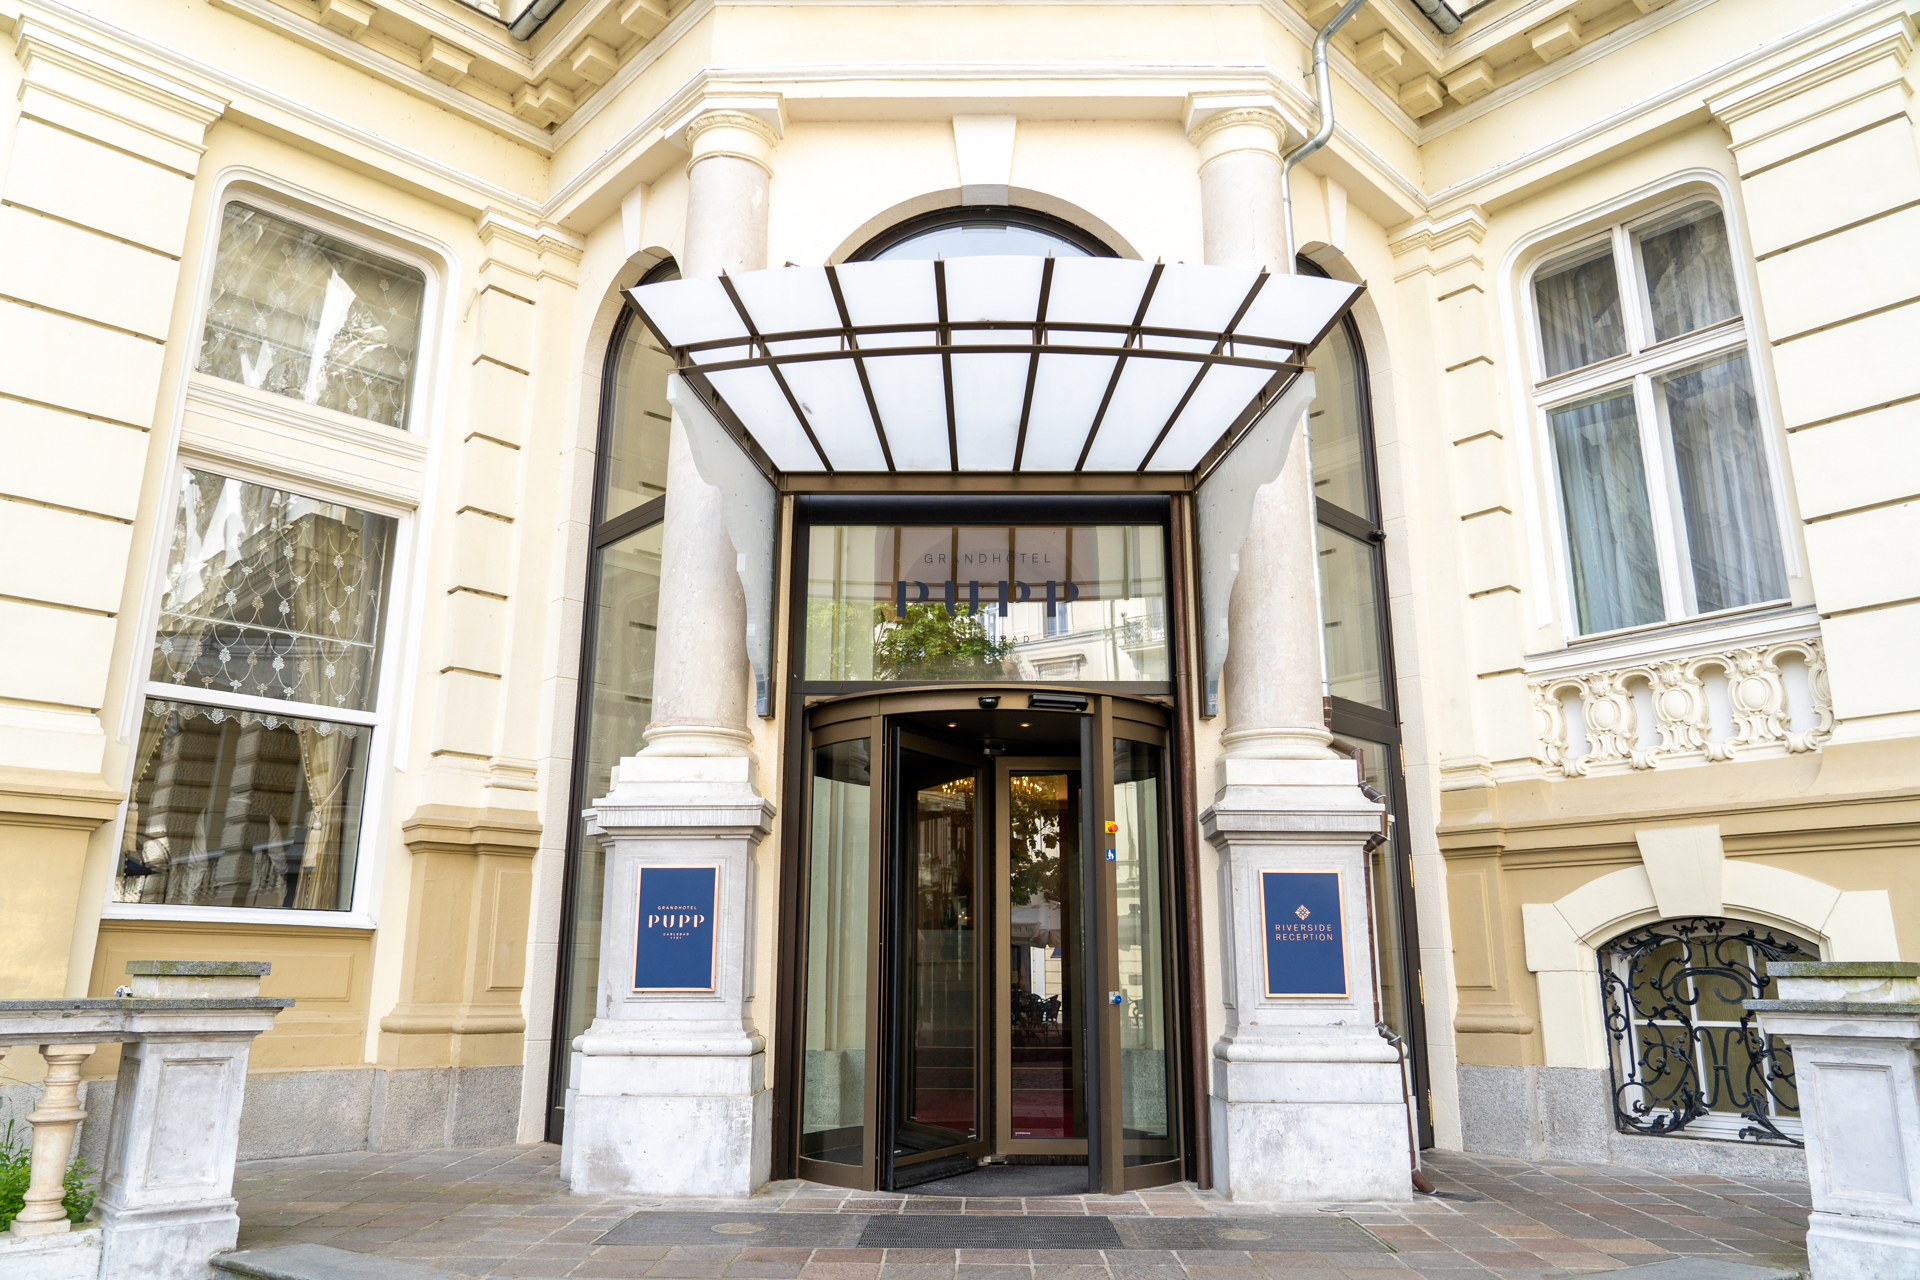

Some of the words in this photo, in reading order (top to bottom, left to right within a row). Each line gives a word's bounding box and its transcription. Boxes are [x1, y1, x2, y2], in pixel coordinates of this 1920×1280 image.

[924, 553, 1051, 564] GRANDHOTEL
[896, 580, 1079, 618] PUPP
[648, 914, 705, 928] PUPP
[1275, 924, 1332, 932] RIVERSIDE
[1275, 933, 1333, 941] RECEPTION
